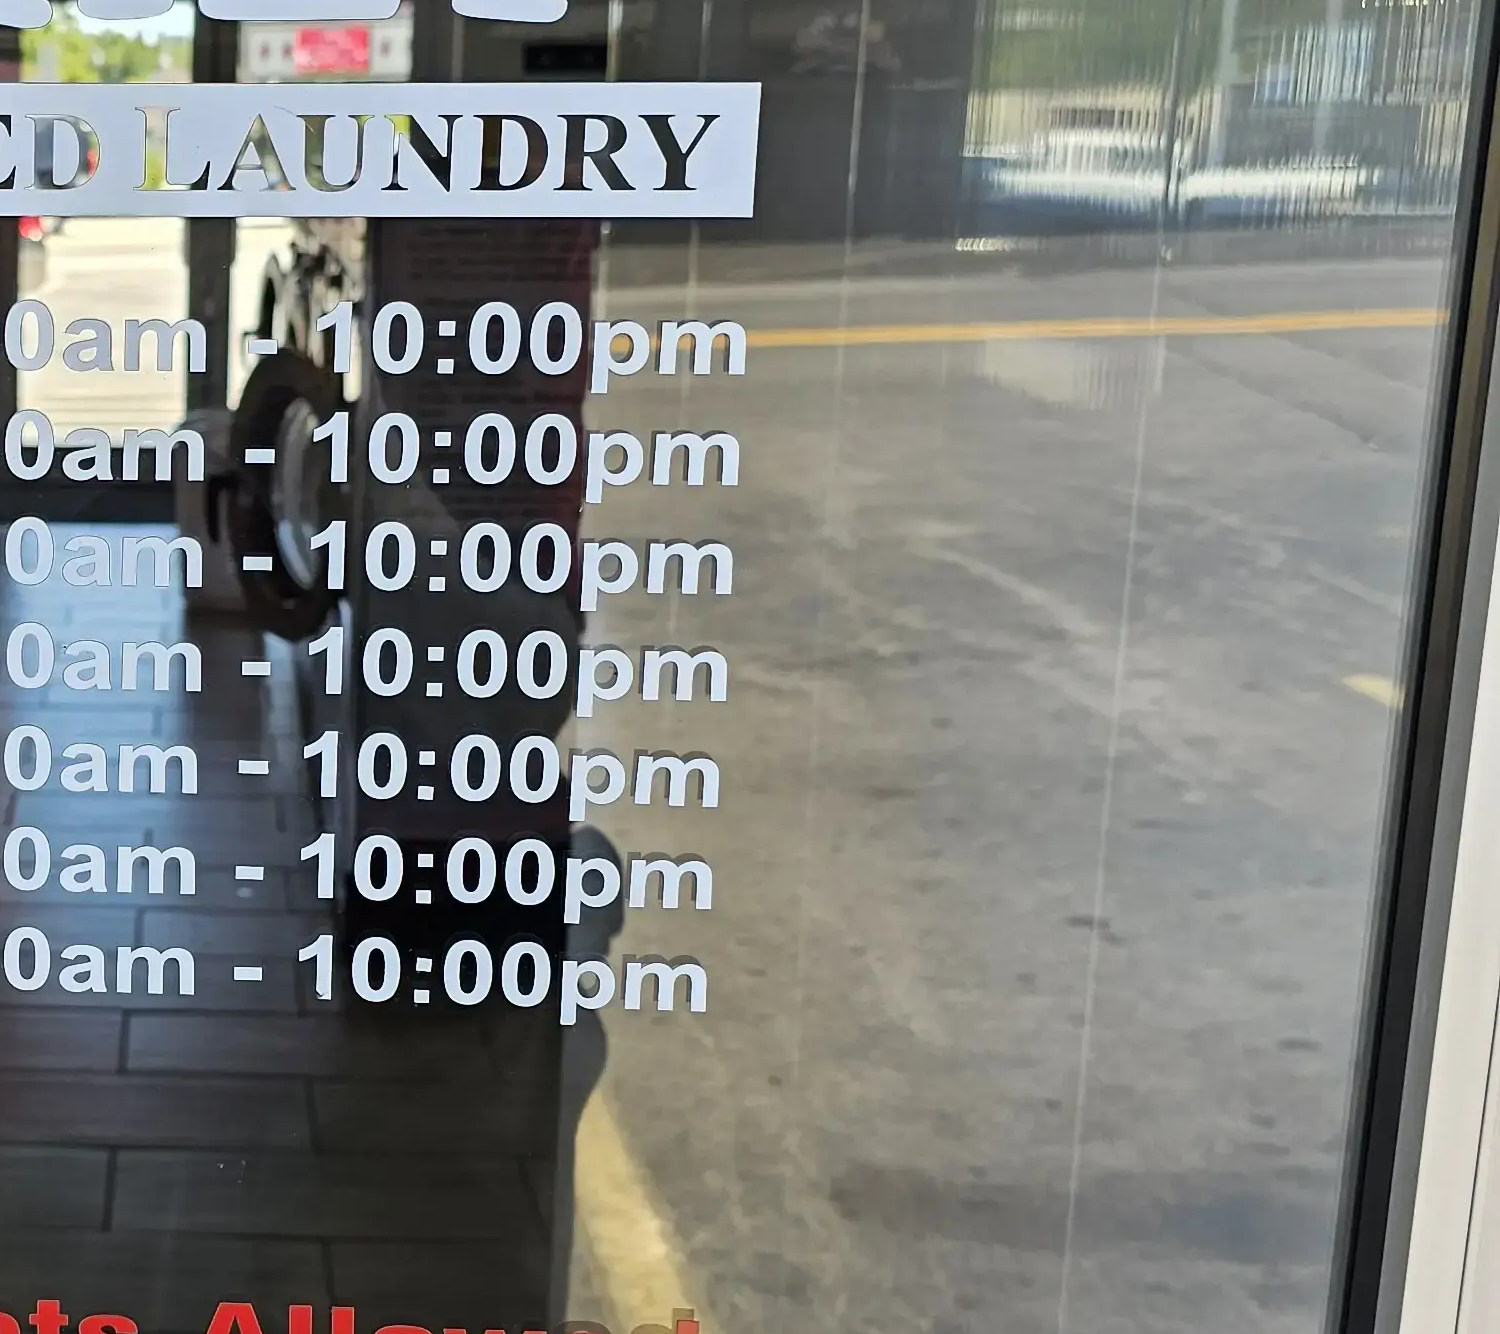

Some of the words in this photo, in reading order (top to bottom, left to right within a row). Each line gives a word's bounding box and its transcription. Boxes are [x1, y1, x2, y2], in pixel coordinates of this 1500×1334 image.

[134, 106, 721, 193] LAUNDRY
[246, 339, 278, 357] -
[315, 300, 747, 394] 10:00pm
[244, 447, 276, 464] -
[312, 411, 740, 503] 10:00pm
[242, 555, 273, 572] -
[308, 520, 734, 611] 10:00pm
[241, 660, 272, 676] -
[307, 626, 729, 718] 10:00pm
[237, 760, 268, 776] -
[303, 730, 721, 822] 10:00pm
[234, 866, 265, 881] -
[300, 833, 713, 923] 10:00pm
[233, 965, 263, 980] -
[297, 933, 708, 1026] 10:00pm
